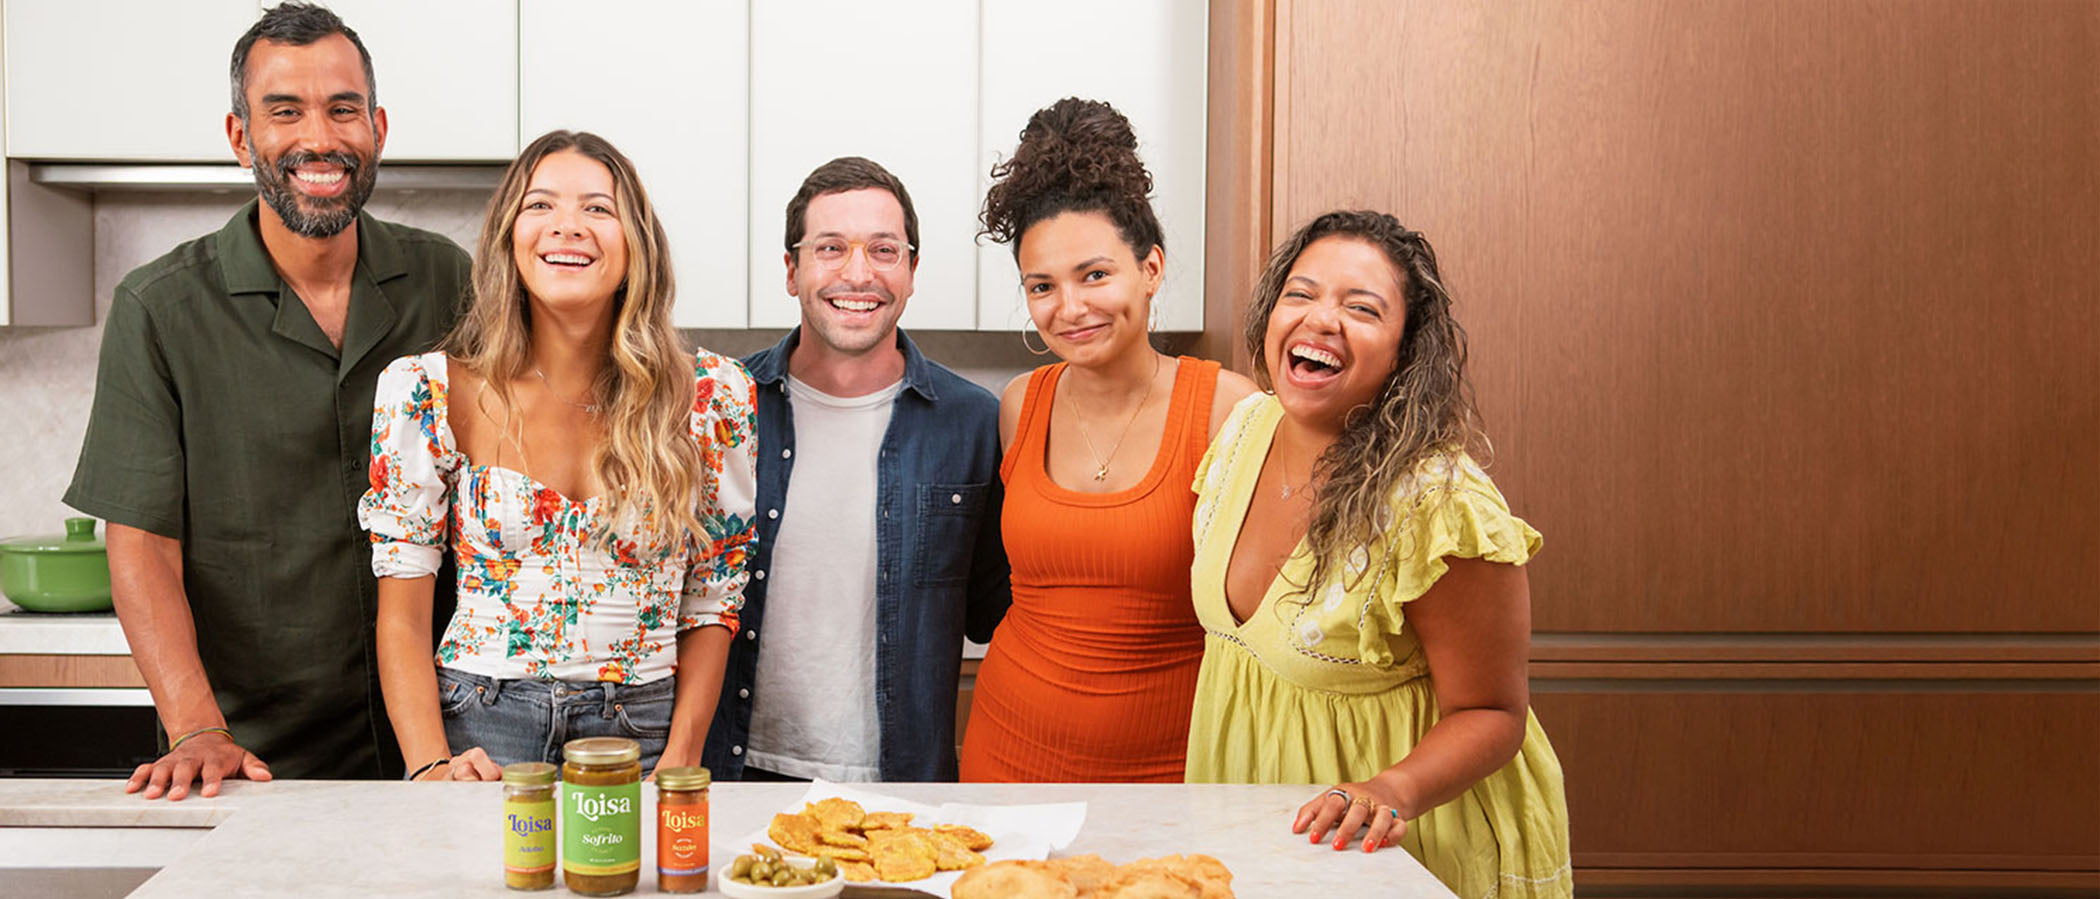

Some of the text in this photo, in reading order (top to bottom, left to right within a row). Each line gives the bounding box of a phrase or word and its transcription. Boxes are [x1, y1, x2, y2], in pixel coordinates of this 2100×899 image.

[572, 792, 631, 822] Loisa
[508, 814, 552, 837] Loisa
[662, 810, 705, 832] Loisa
[582, 833, 624, 846] Sofrito
